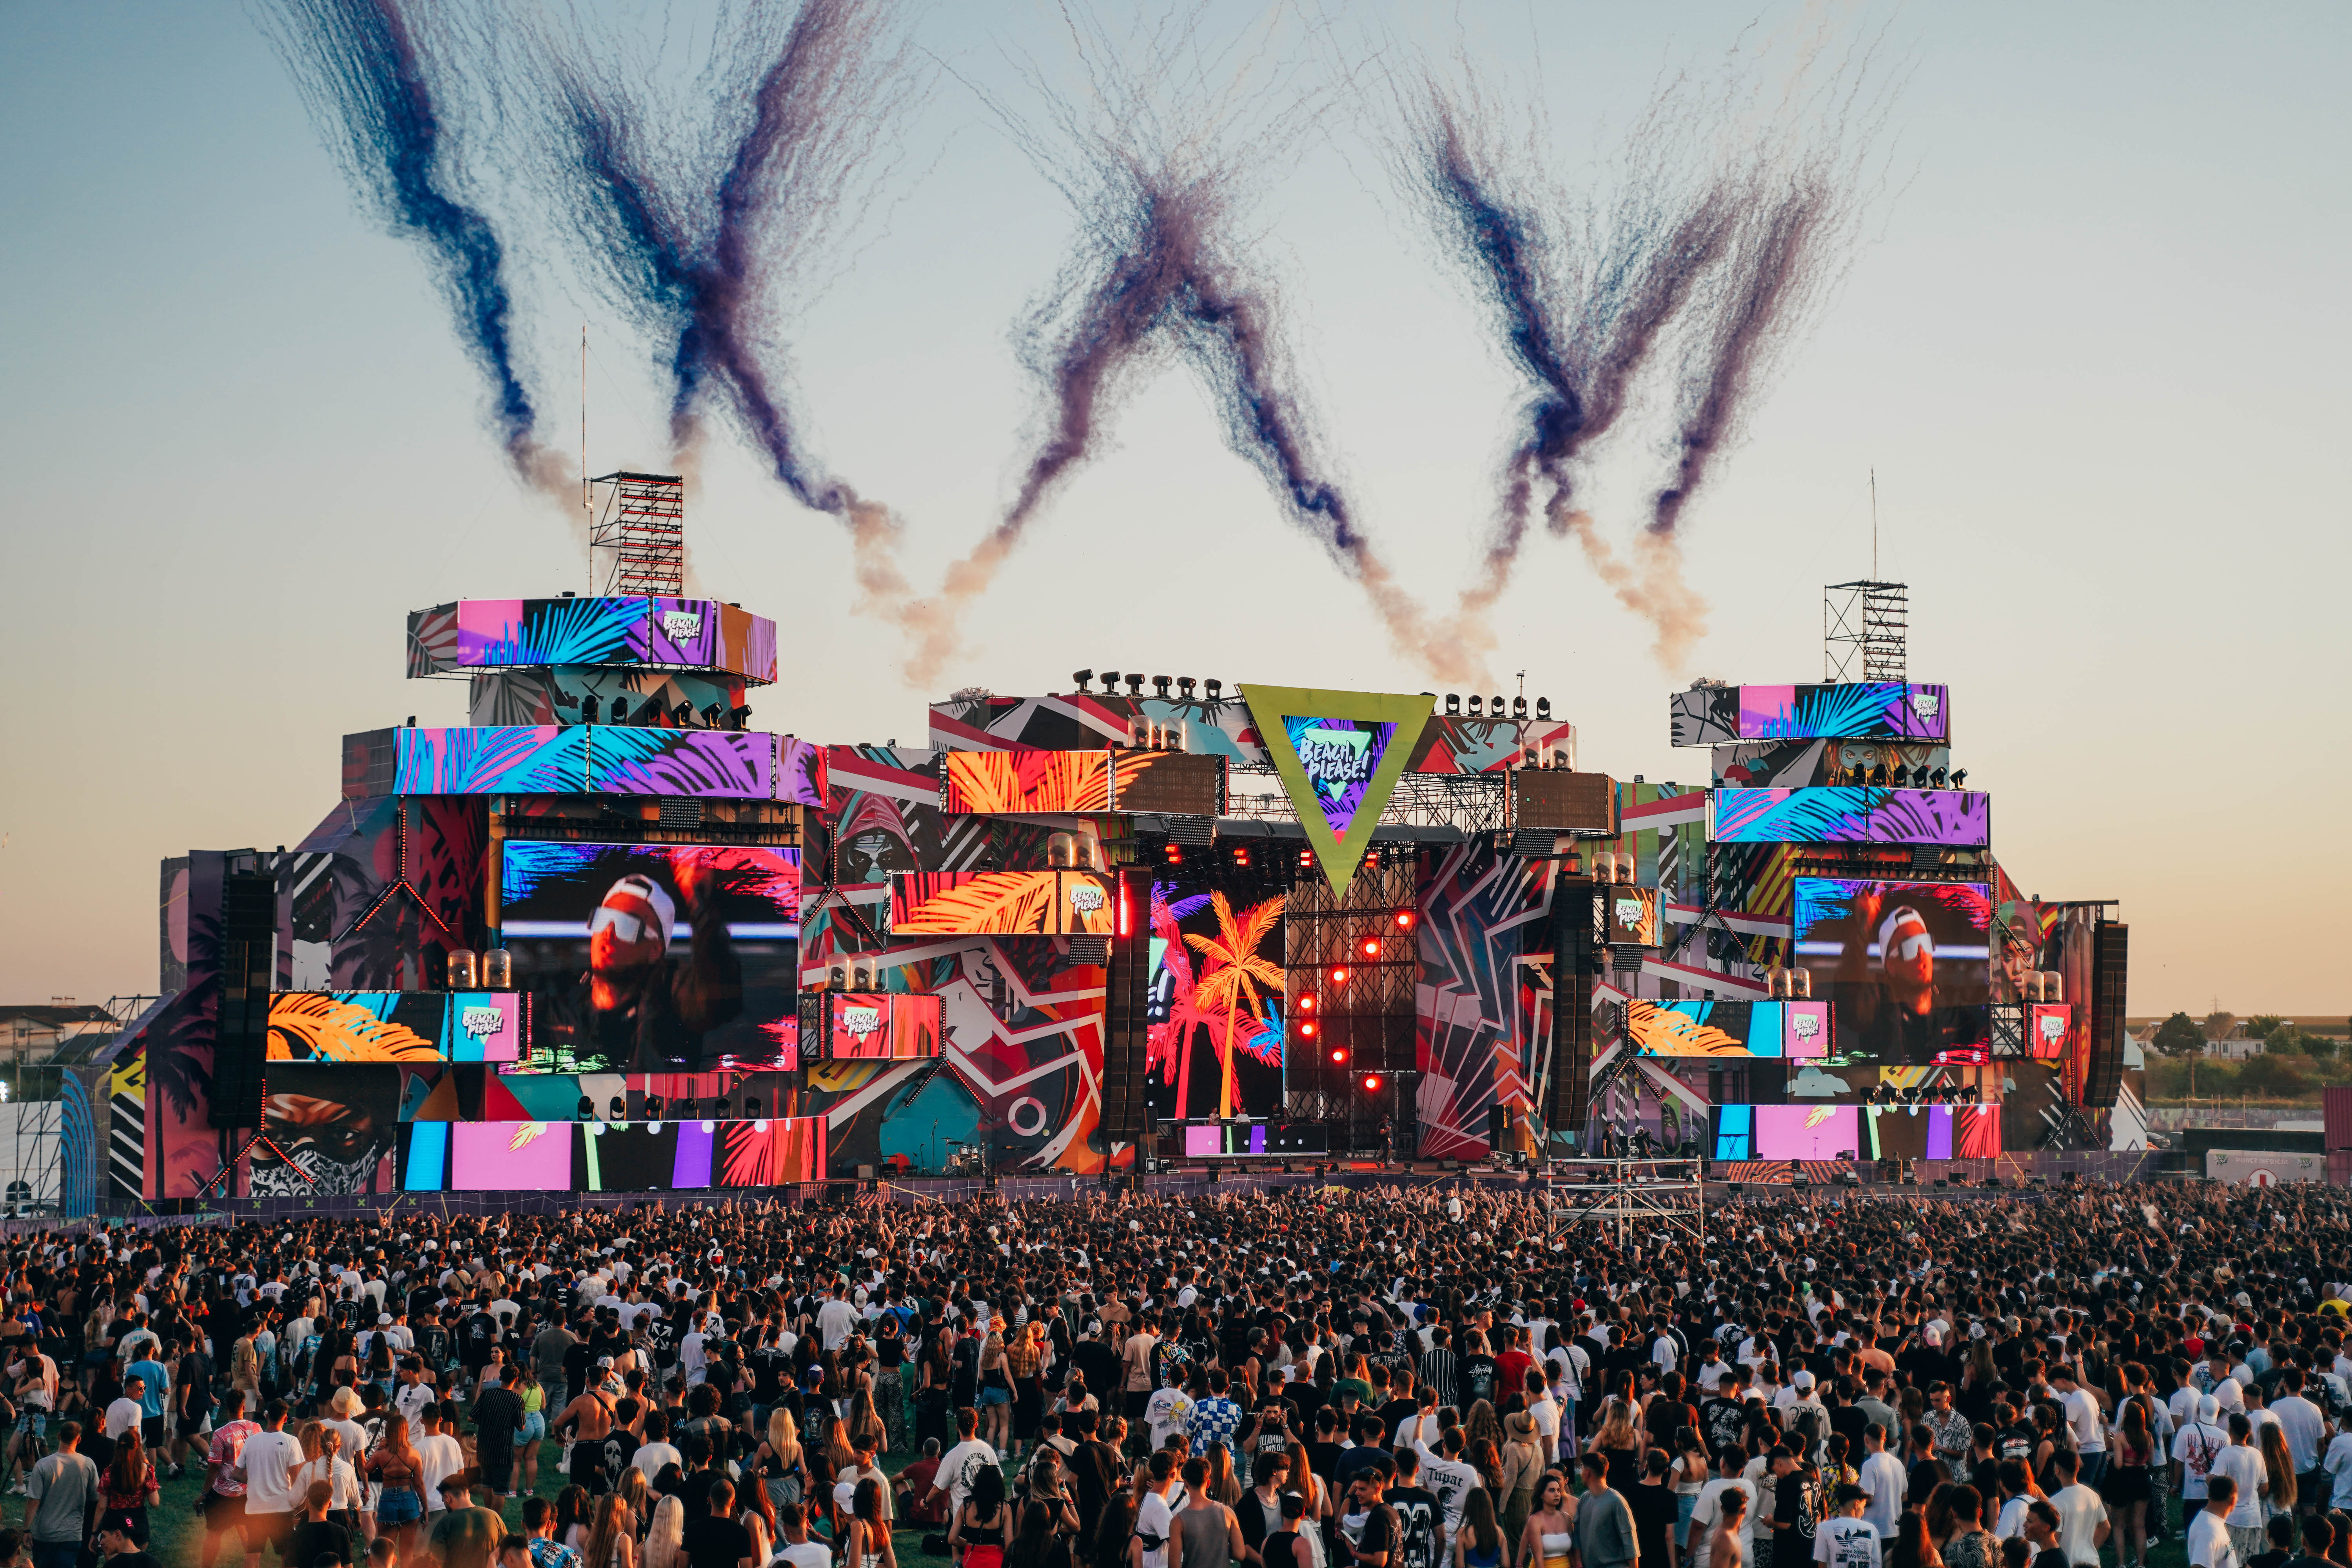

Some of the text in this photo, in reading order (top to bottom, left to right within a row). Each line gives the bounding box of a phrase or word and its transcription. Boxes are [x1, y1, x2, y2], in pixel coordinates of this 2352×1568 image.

[668, 622, 701, 642] PLEASE!
[1916, 703, 1938, 719] PLEASE!
[1307, 750, 1370, 784] PLEASE!
[1074, 895, 1103, 915] PLEASE!
[1619, 909, 1643, 926] PLEASE!
[467, 1017, 503, 1039] PLEASE!
[847, 1016, 879, 1037] PLEASE!
[1796, 1022, 1819, 1040] PLEASE!
[2044, 1024, 2065, 1041] PLEASE!
[1789, 1406, 1824, 1425] 2PAC
[1427, 1468, 1463, 1487] Tupac
